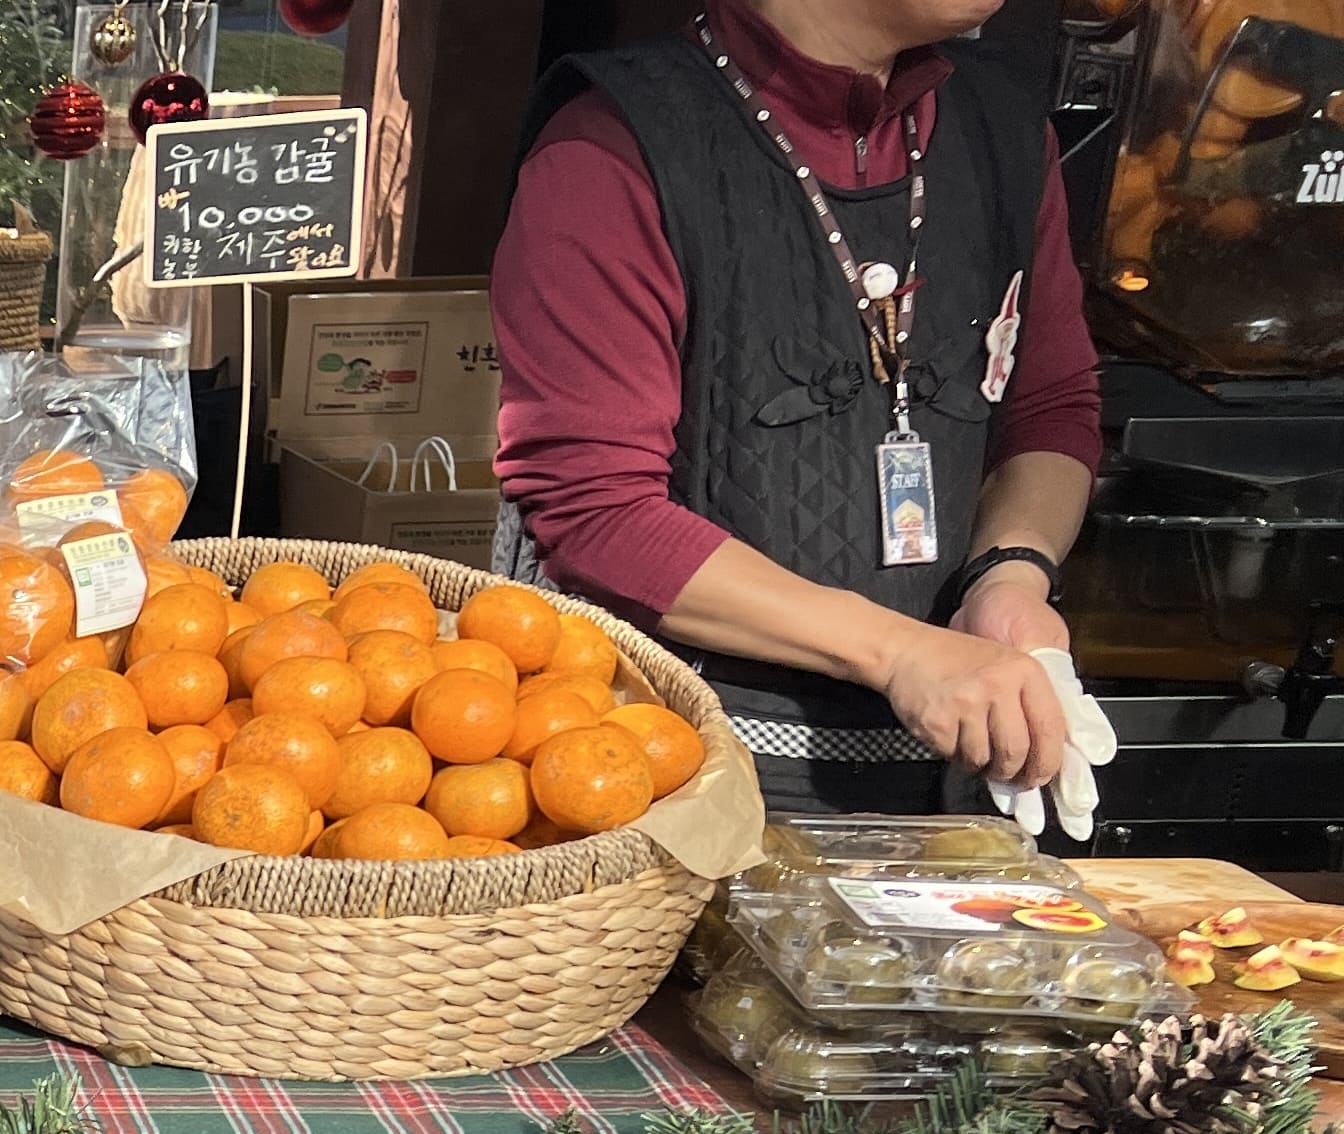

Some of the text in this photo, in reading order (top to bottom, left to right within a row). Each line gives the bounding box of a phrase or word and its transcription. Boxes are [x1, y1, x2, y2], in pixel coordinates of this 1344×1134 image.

[164, 138, 336, 186] 유기농 감귤
[891, 473, 920, 489] STAFF
